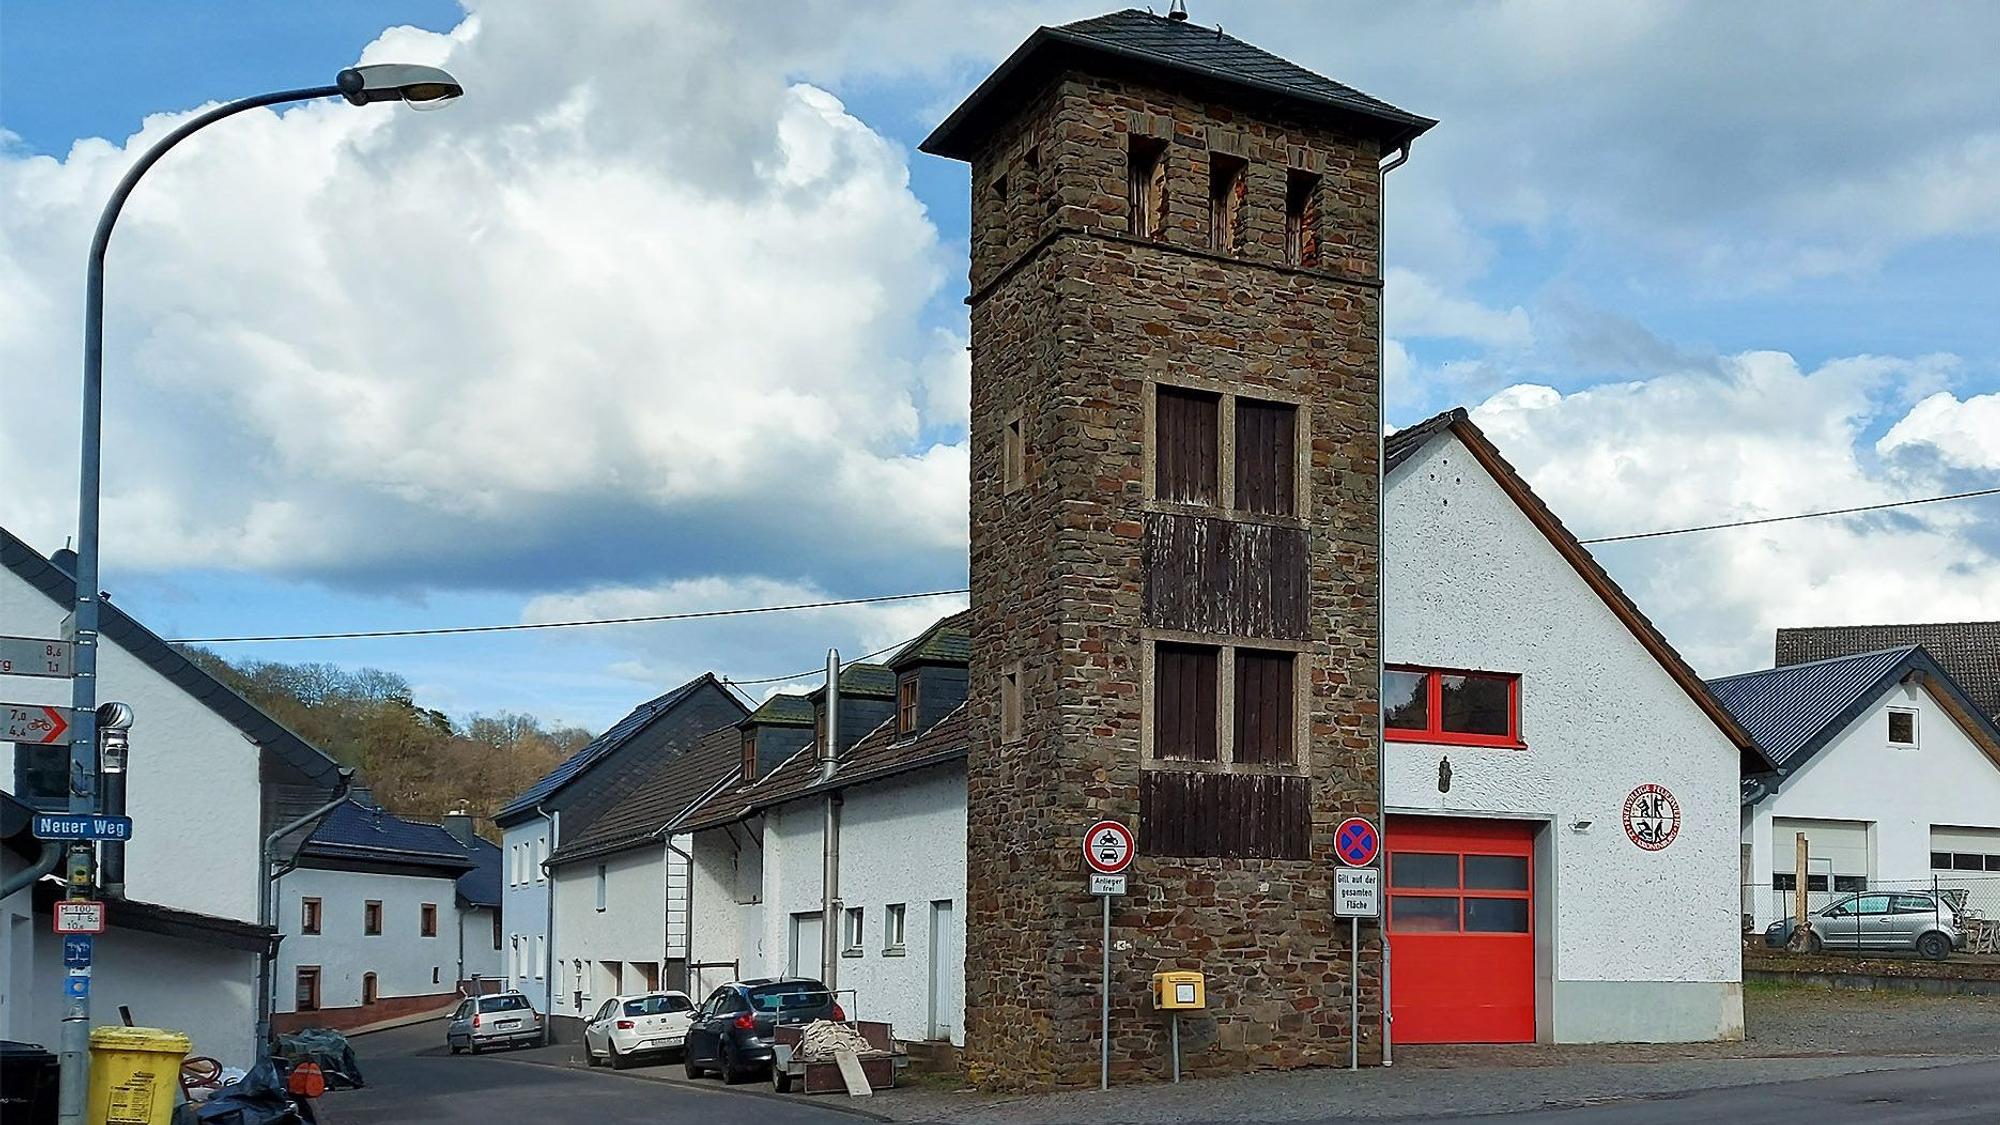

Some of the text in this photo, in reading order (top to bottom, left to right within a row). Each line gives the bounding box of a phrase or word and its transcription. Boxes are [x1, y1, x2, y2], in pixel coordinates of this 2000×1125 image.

[40, 818, 124, 837] Neuer Weg
[1095, 877, 1123, 886] Anlieger
[1352, 875, 1363, 883] auf
[1342, 889, 1372, 898] gesamten
[1346, 900, 1367, 909] Fläche
